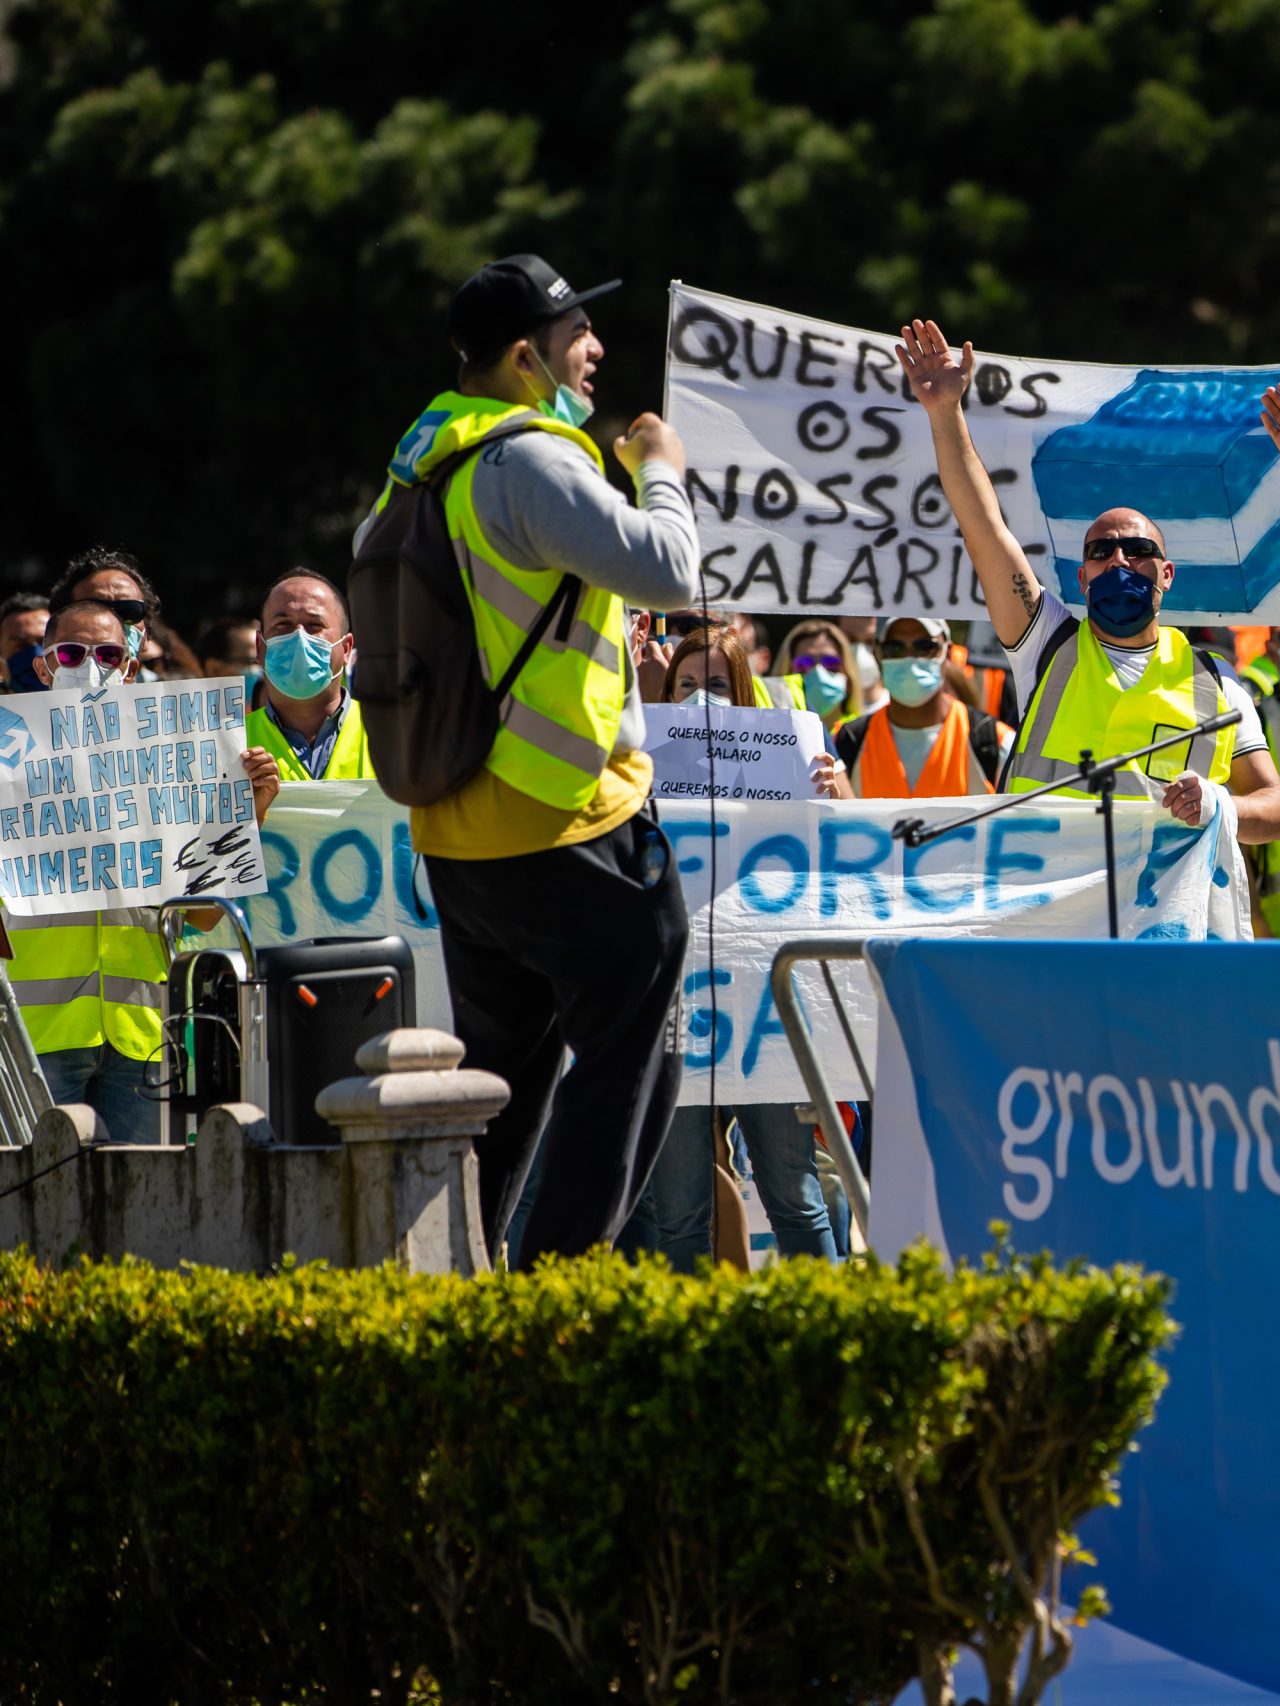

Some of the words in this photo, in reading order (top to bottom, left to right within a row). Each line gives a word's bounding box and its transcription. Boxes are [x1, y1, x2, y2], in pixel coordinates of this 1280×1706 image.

[671, 305, 1060, 418] QUEROS
[797, 400, 906, 460] OS
[700, 527, 1047, 609] SALÁRI
[51, 689, 120, 750] NÃO
[134, 686, 244, 739] SOMOS
[668, 727, 735, 742] QUEREMOS
[739, 731, 749, 743] O
[753, 733, 797, 746] NOSSO
[25, 755, 75, 798] UM
[706, 748, 761, 763] SALARIO
[661, 781, 729, 797] QUEREMOS
[733, 787, 743, 798] O
[747, 788, 791, 800] NOSSO
